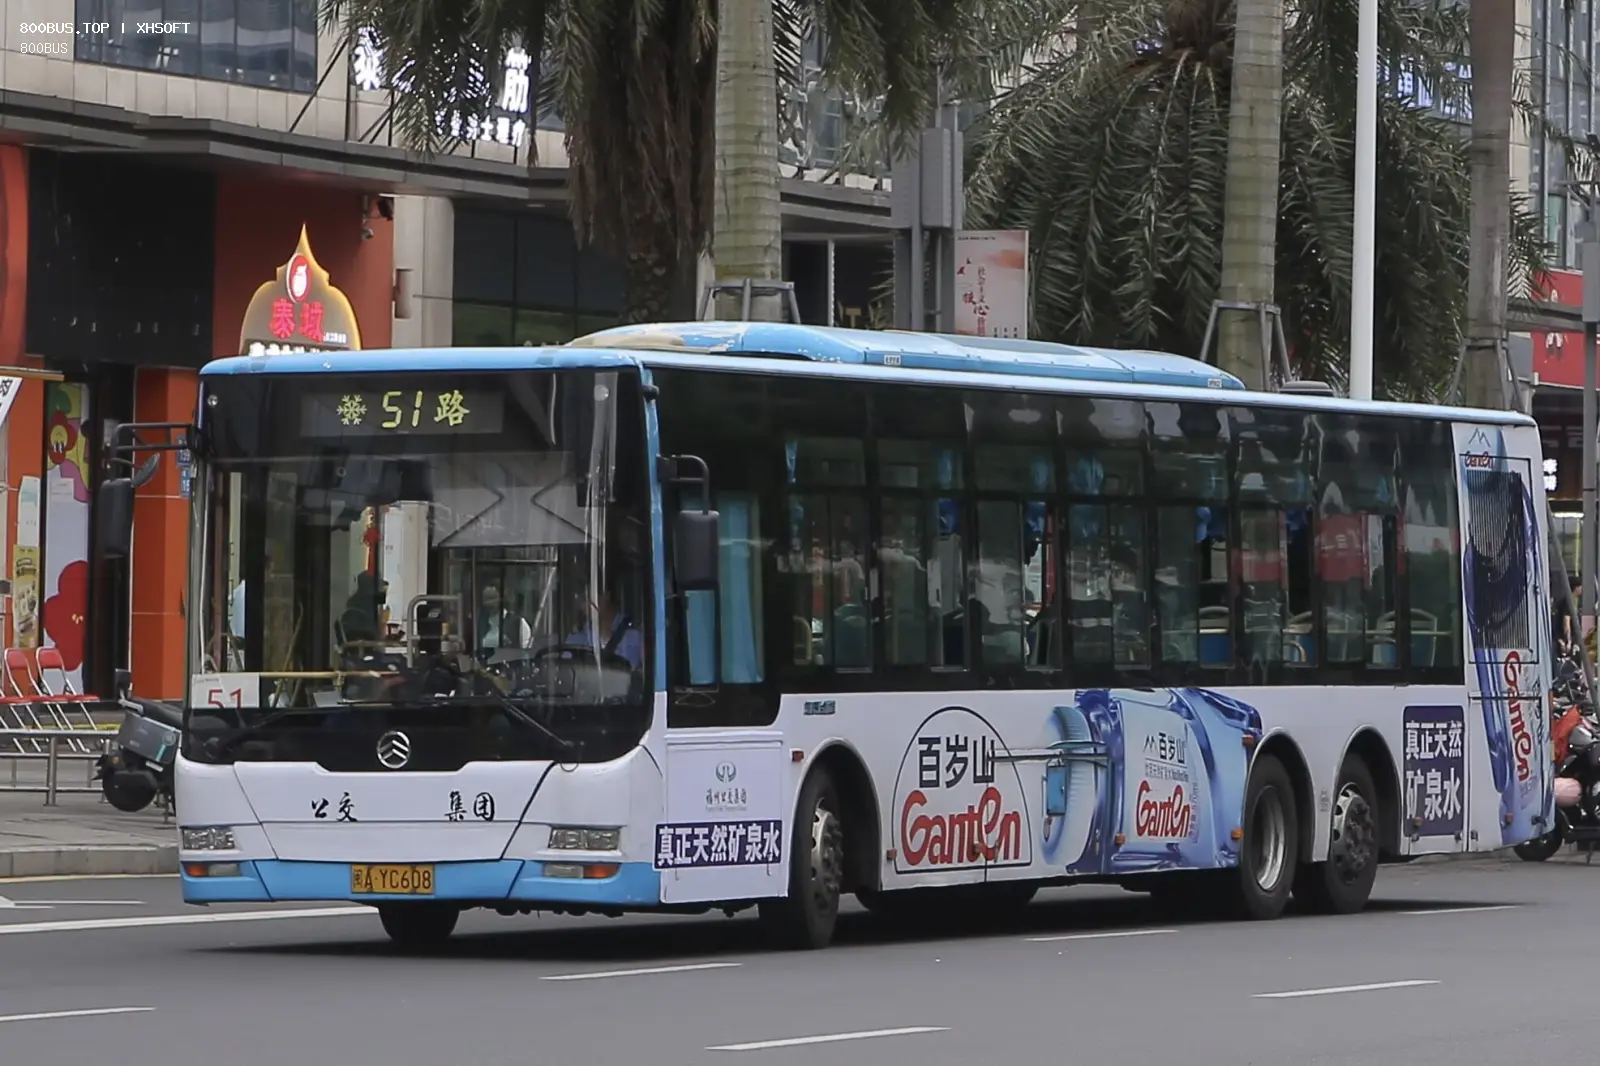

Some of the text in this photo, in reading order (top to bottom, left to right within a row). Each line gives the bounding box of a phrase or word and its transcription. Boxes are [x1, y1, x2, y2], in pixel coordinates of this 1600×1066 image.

[208, 687, 242, 709] 51
[917, 733, 996, 788] 百岁山
[1158, 731, 1186, 764] 百岁山
[1405, 720, 1463, 761] 真正天然
[310, 790, 496, 822] 公交 集团
[1136, 779, 1191, 838] Ganten
[1405, 767, 1462, 821] 矿泉水
[656, 821, 781, 867] 真正天然矿泉水
[900, 785, 1022, 866] Ganten
